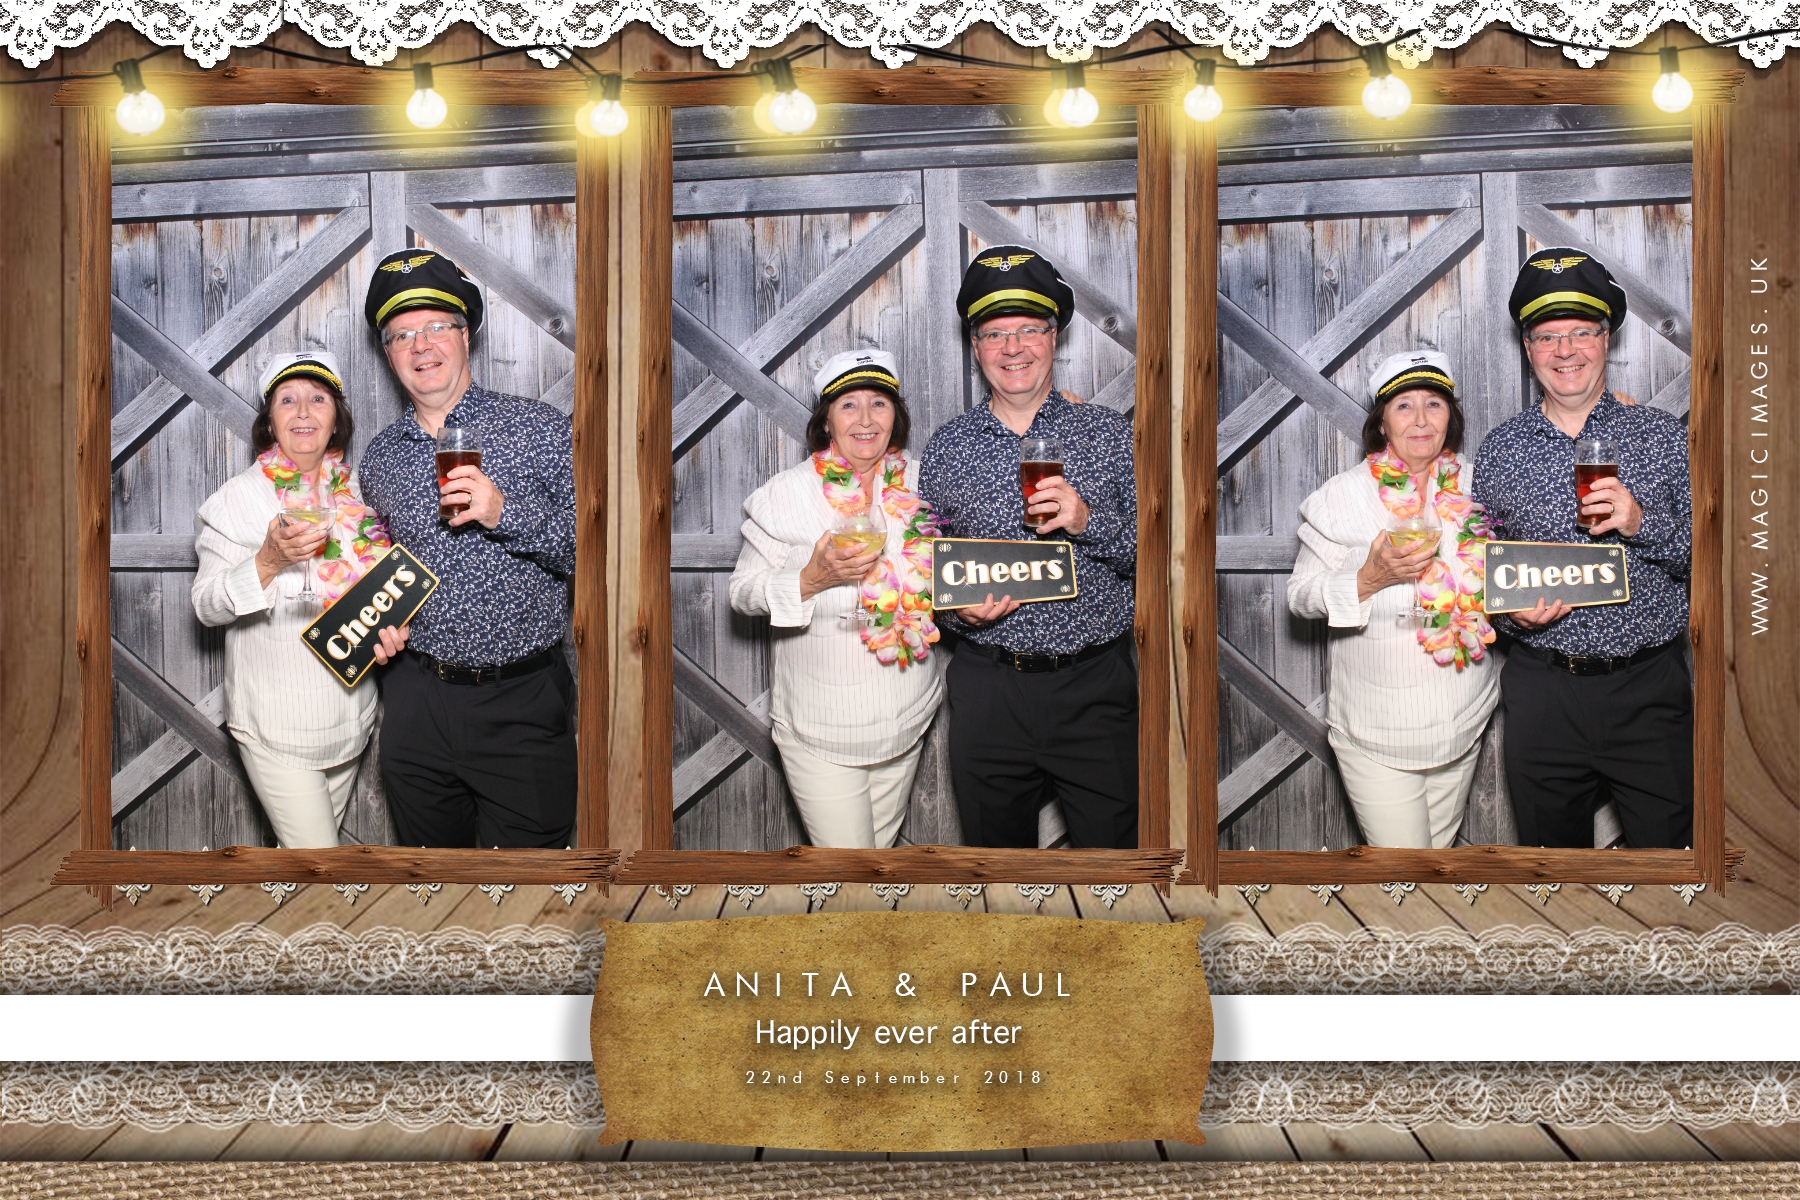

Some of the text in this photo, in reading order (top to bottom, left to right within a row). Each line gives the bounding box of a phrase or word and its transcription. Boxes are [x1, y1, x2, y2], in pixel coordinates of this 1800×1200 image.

[941, 559, 1064, 586] Cheers
[1493, 563, 1617, 590] Cheers
[326, 565, 417, 660] Cheers
